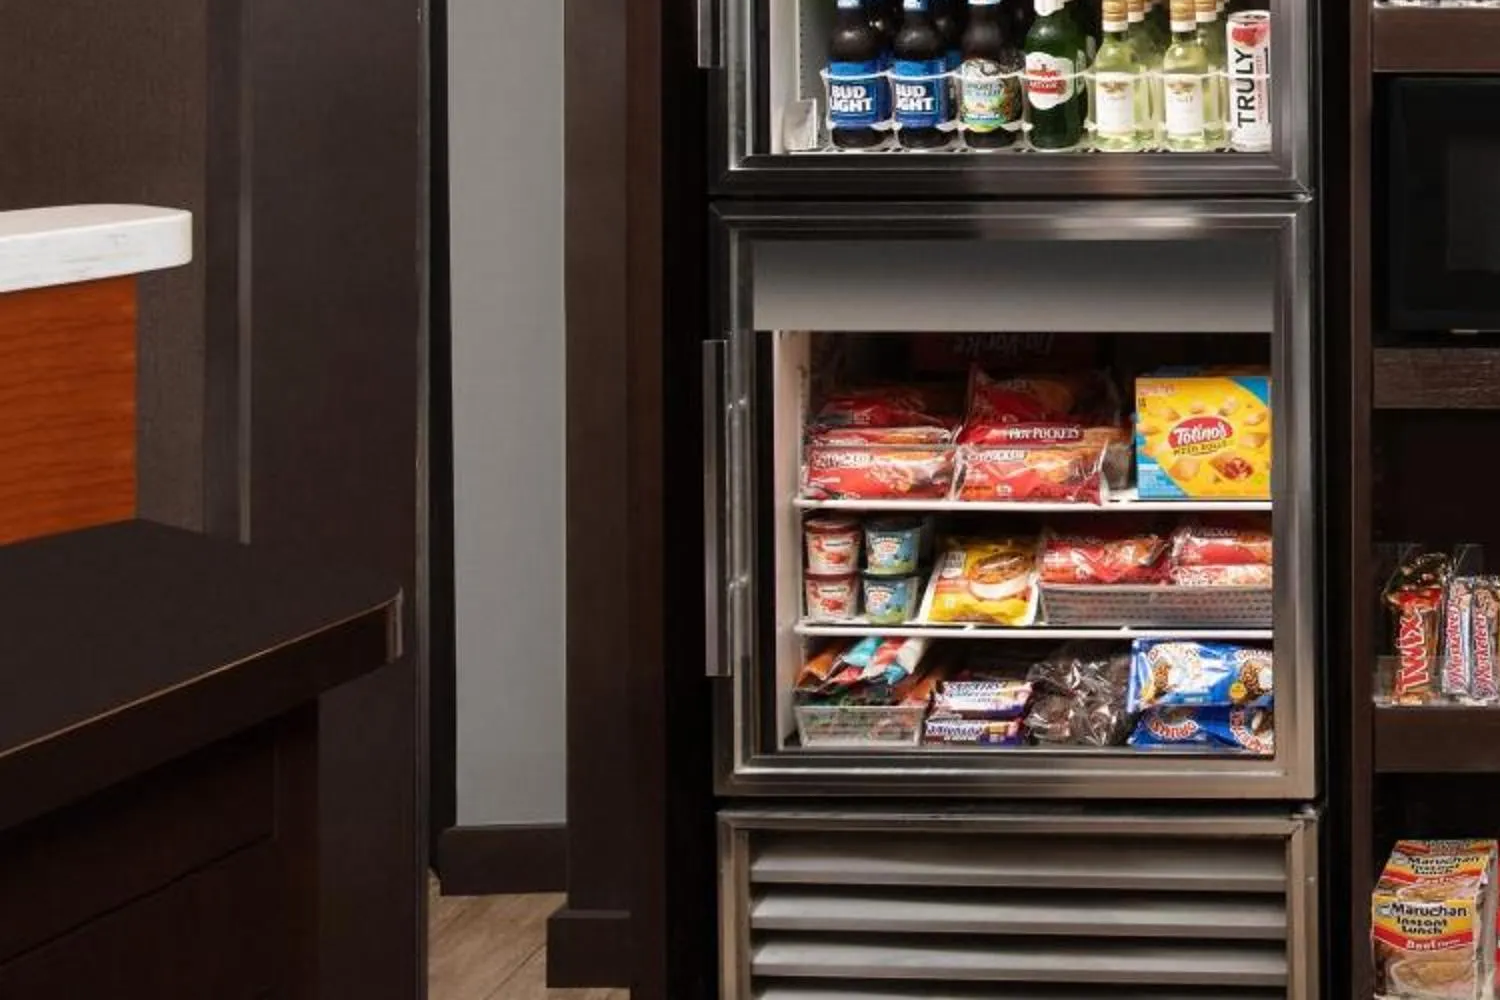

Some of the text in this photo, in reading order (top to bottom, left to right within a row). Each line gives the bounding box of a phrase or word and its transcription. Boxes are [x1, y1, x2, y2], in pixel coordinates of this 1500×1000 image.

[831, 85, 867, 99] BUD
[1237, 48, 1256, 129] TRULY
[1174, 421, 1228, 445] Totino's
[1397, 612, 1430, 694] TWIX
[1391, 902, 1468, 917] Maruchan
